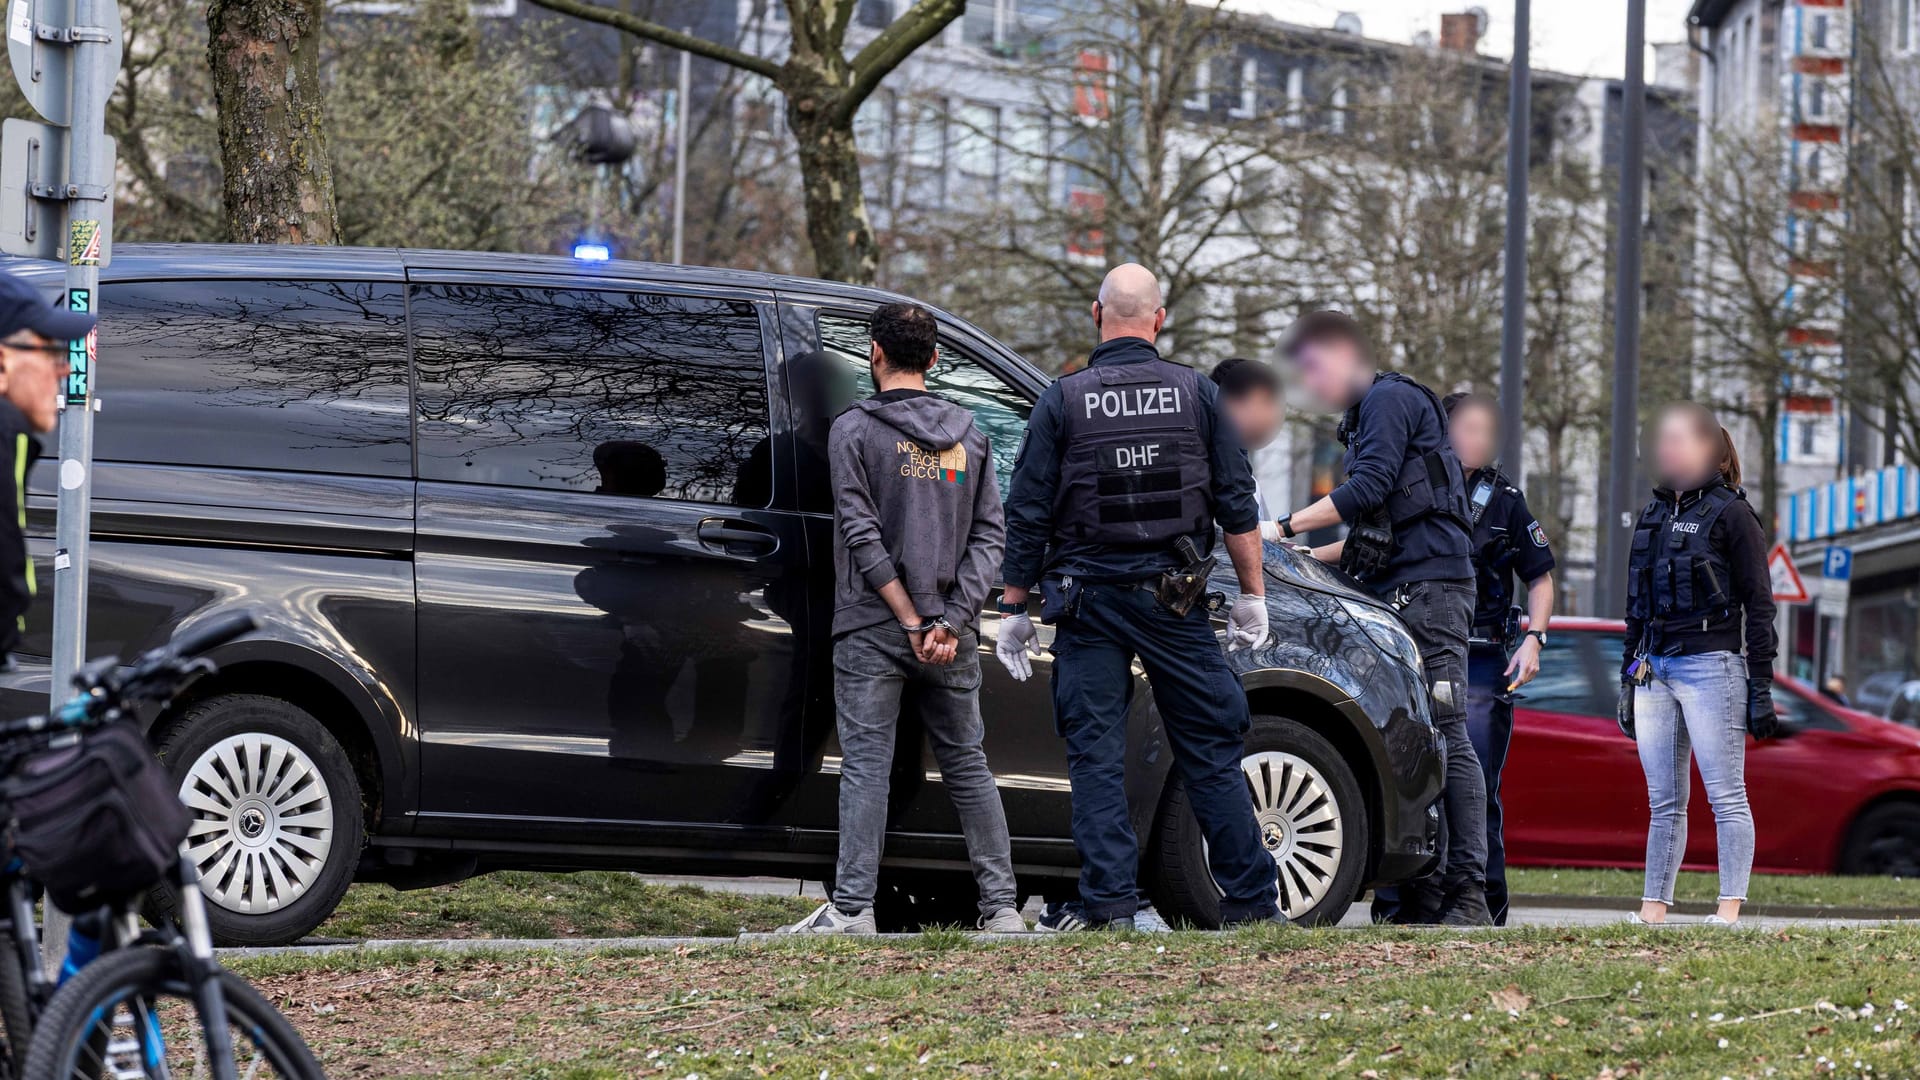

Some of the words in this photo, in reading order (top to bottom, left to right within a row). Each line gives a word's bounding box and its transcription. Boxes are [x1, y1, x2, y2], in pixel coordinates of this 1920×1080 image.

[1084, 387, 1181, 419] POLIZEI
[910, 453, 940, 468] FACE
[1116, 444, 1160, 468] DHF
[900, 464, 940, 480] GUCCI
[1828, 549, 1847, 577] P
